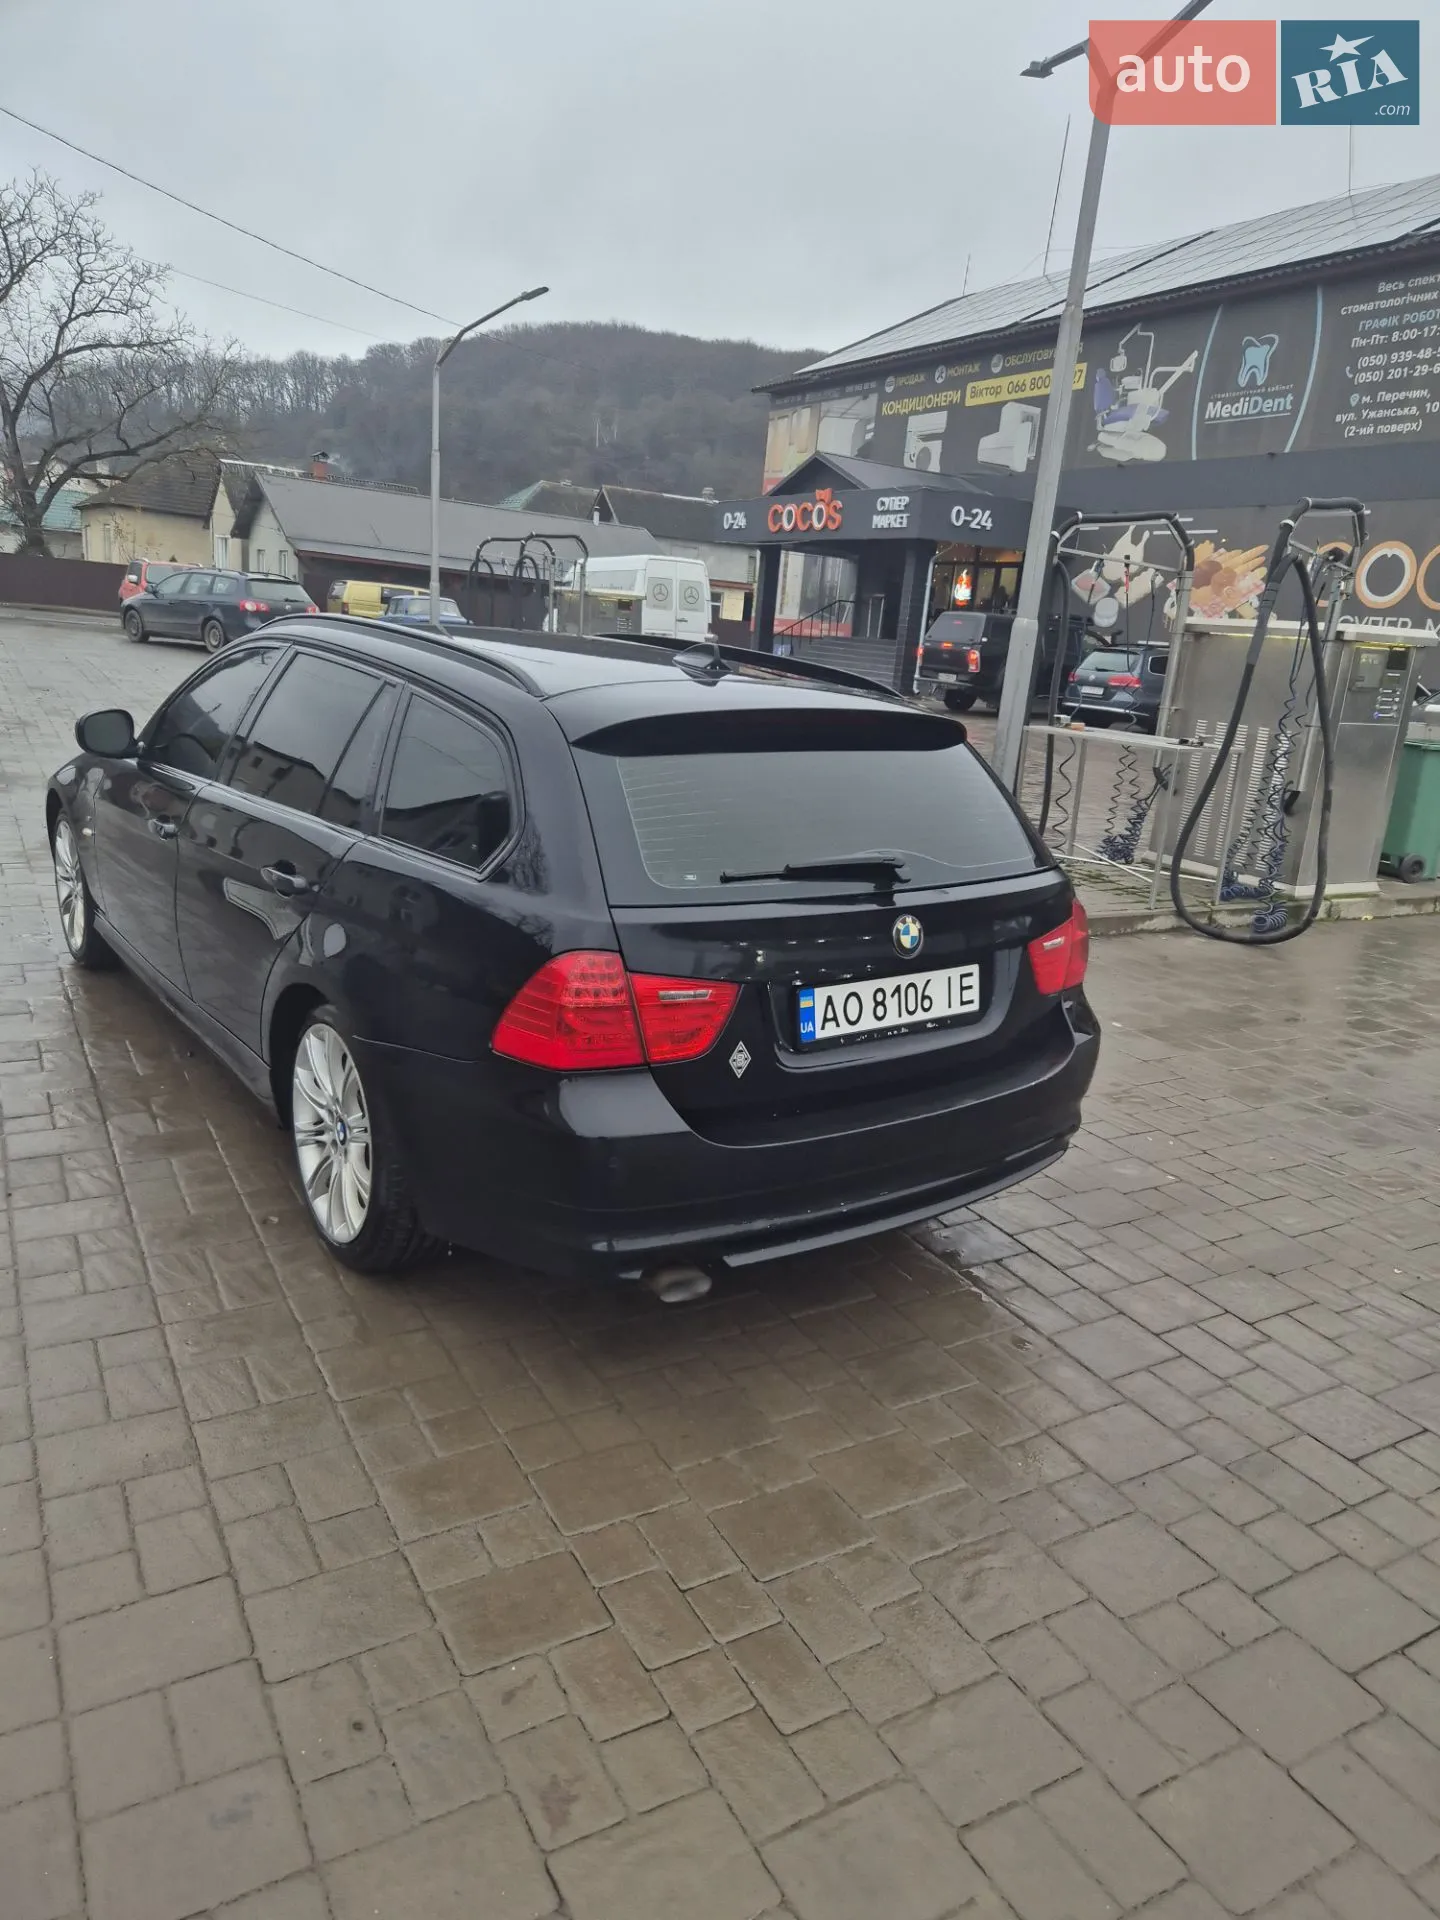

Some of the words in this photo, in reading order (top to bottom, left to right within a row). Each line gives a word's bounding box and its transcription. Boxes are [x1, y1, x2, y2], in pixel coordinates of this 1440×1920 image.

[1377, 281, 1405, 293] Весь
[1340, 290, 1440, 315] стоматологічних
[1358, 315, 1400, 332] ГРАФІК
[1351, 335, 1389, 348] Пн-Пт:
[1391, 325, 1440, 343] 8:00-17:
[1357, 354, 1387, 369] (050)
[1354, 370, 1384, 385] (050)
[969, 384, 1002, 399] Віктор
[1006, 380, 1027, 395] 066
[1029, 375, 1051, 391] 800
[1376, 389, 1431, 403] Перечин,
[881, 390, 961, 416] КОНДИЦІОНЕРИ
[1204, 393, 1294, 419] MediDent
[1335, 413, 1357, 424] вул.
[1361, 406, 1420, 420] Ужанська,
[1344, 424, 1375, 438] (2-ий
[1376, 418, 1423, 434] поверх)
[876, 496, 910, 511] СУПЕР
[723, 511, 747, 529] 0-24
[872, 513, 911, 528] МАРКЕТ
[951, 506, 993, 530] 0-24
[820, 991, 863, 1031] AO
[872, 979, 933, 1022] 8106
[947, 972, 974, 1009] IE
[800, 1020, 814, 1034] UA
